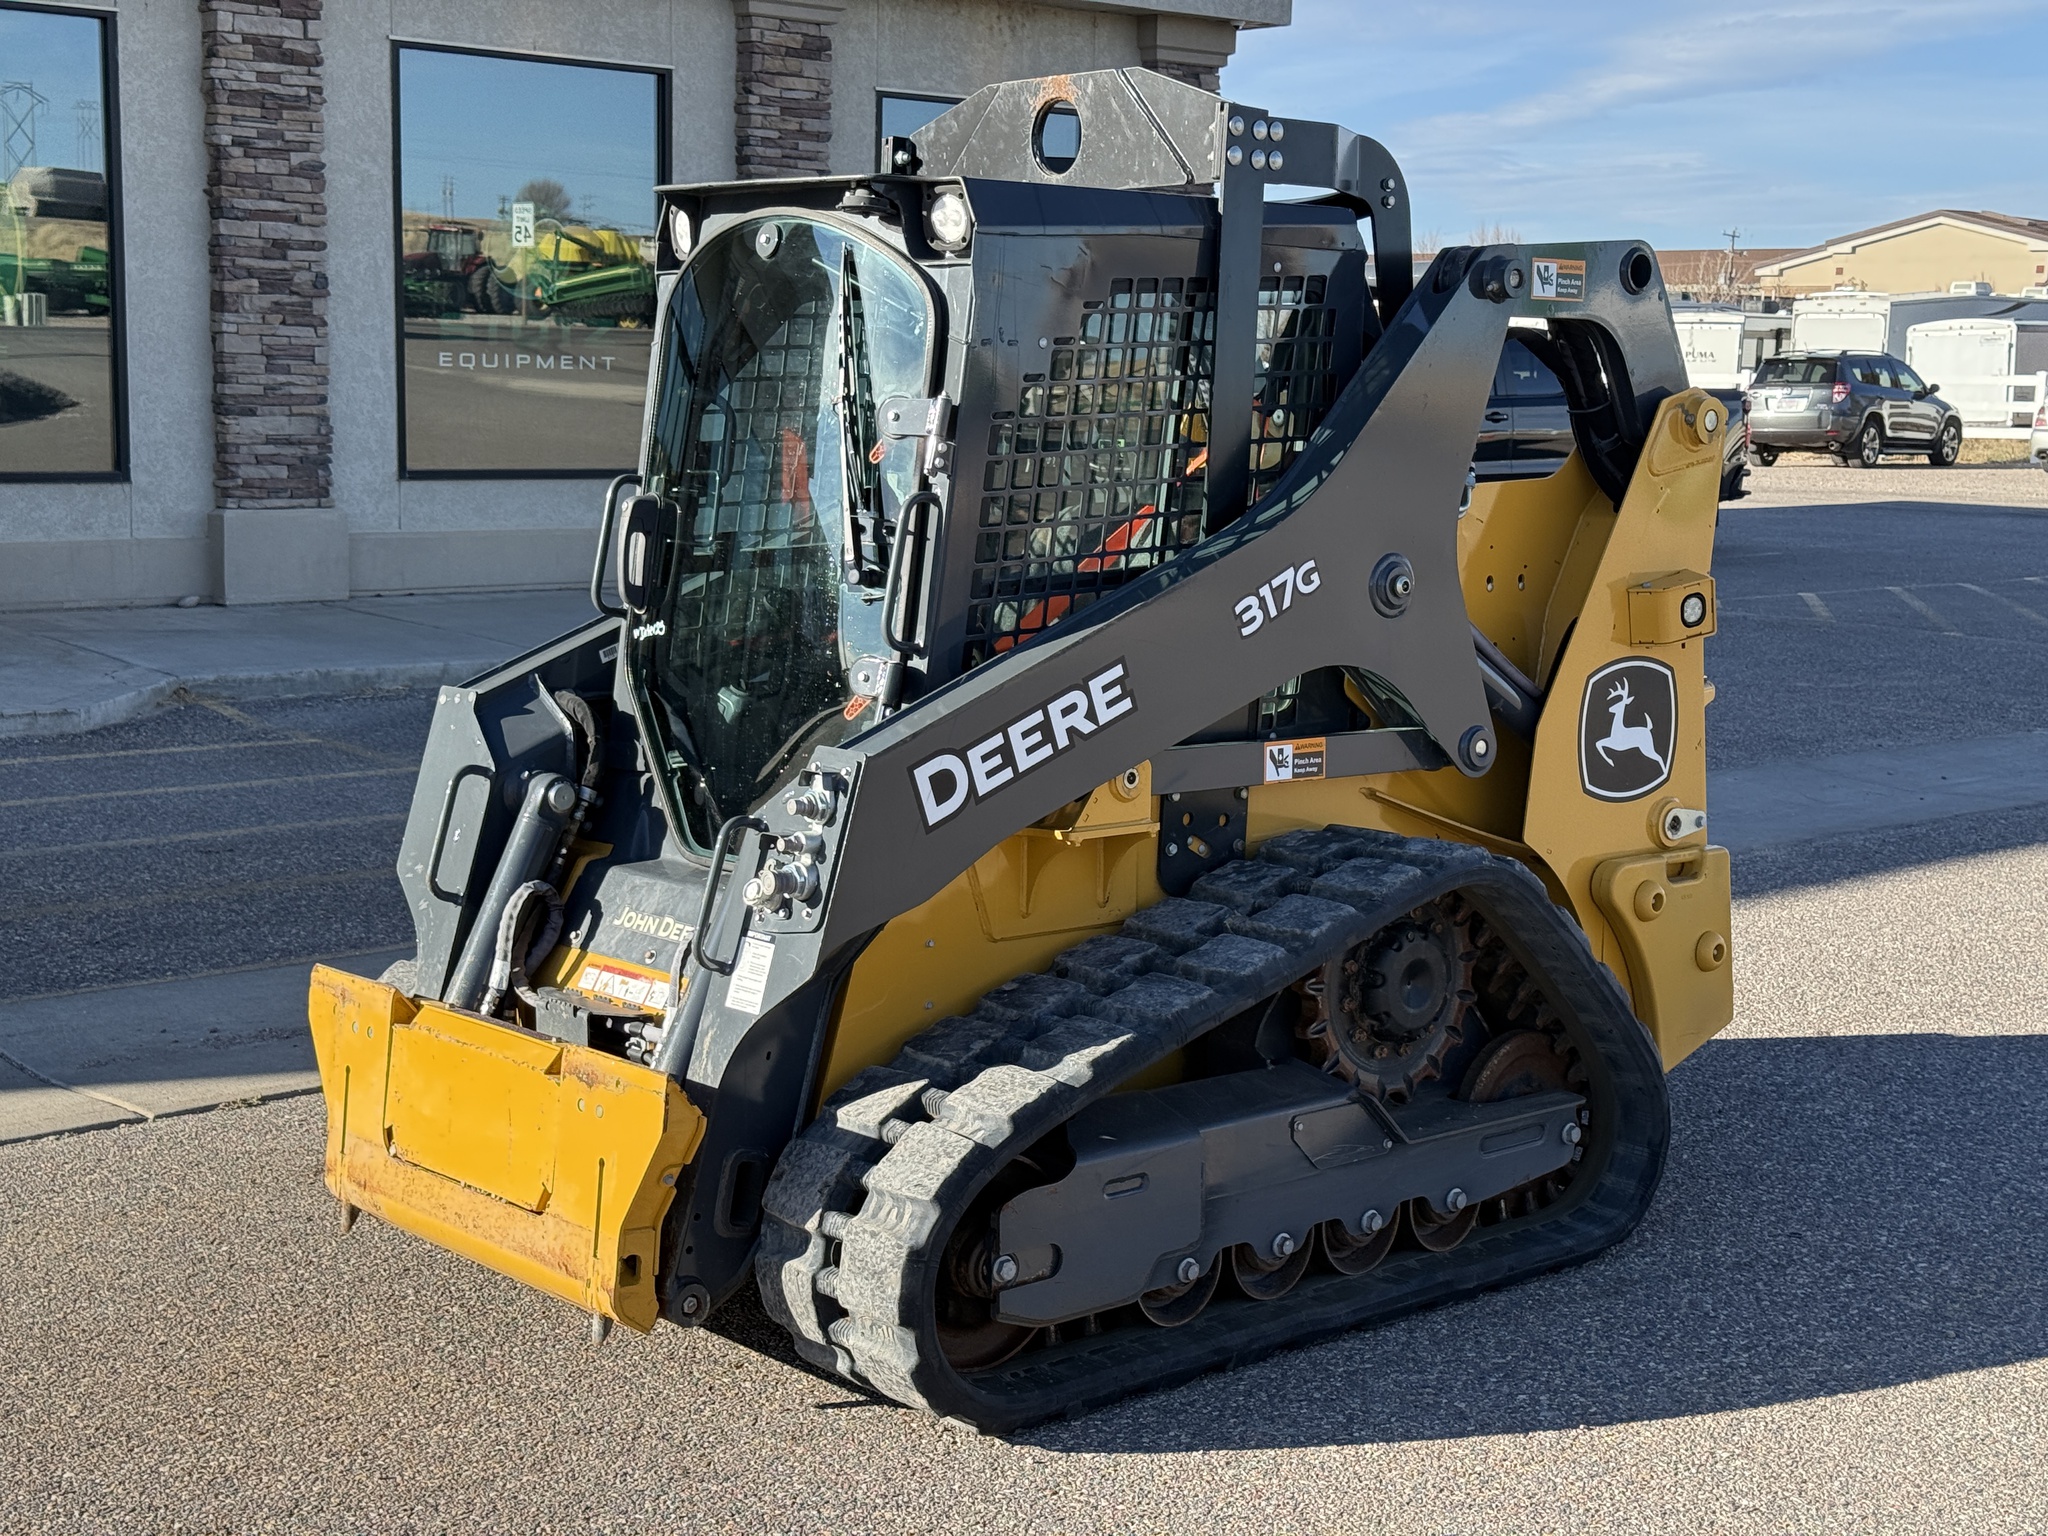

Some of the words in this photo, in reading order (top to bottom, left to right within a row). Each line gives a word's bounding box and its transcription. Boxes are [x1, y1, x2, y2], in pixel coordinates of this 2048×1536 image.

[438, 352, 616, 371] EQUIPMENT
[1685, 347, 1715, 359] PUMA
[1234, 559, 1321, 637] 317G
[913, 663, 1133, 827] DEERE
[613, 905, 660, 934] JOHN
[657, 916, 696, 943] DEE
